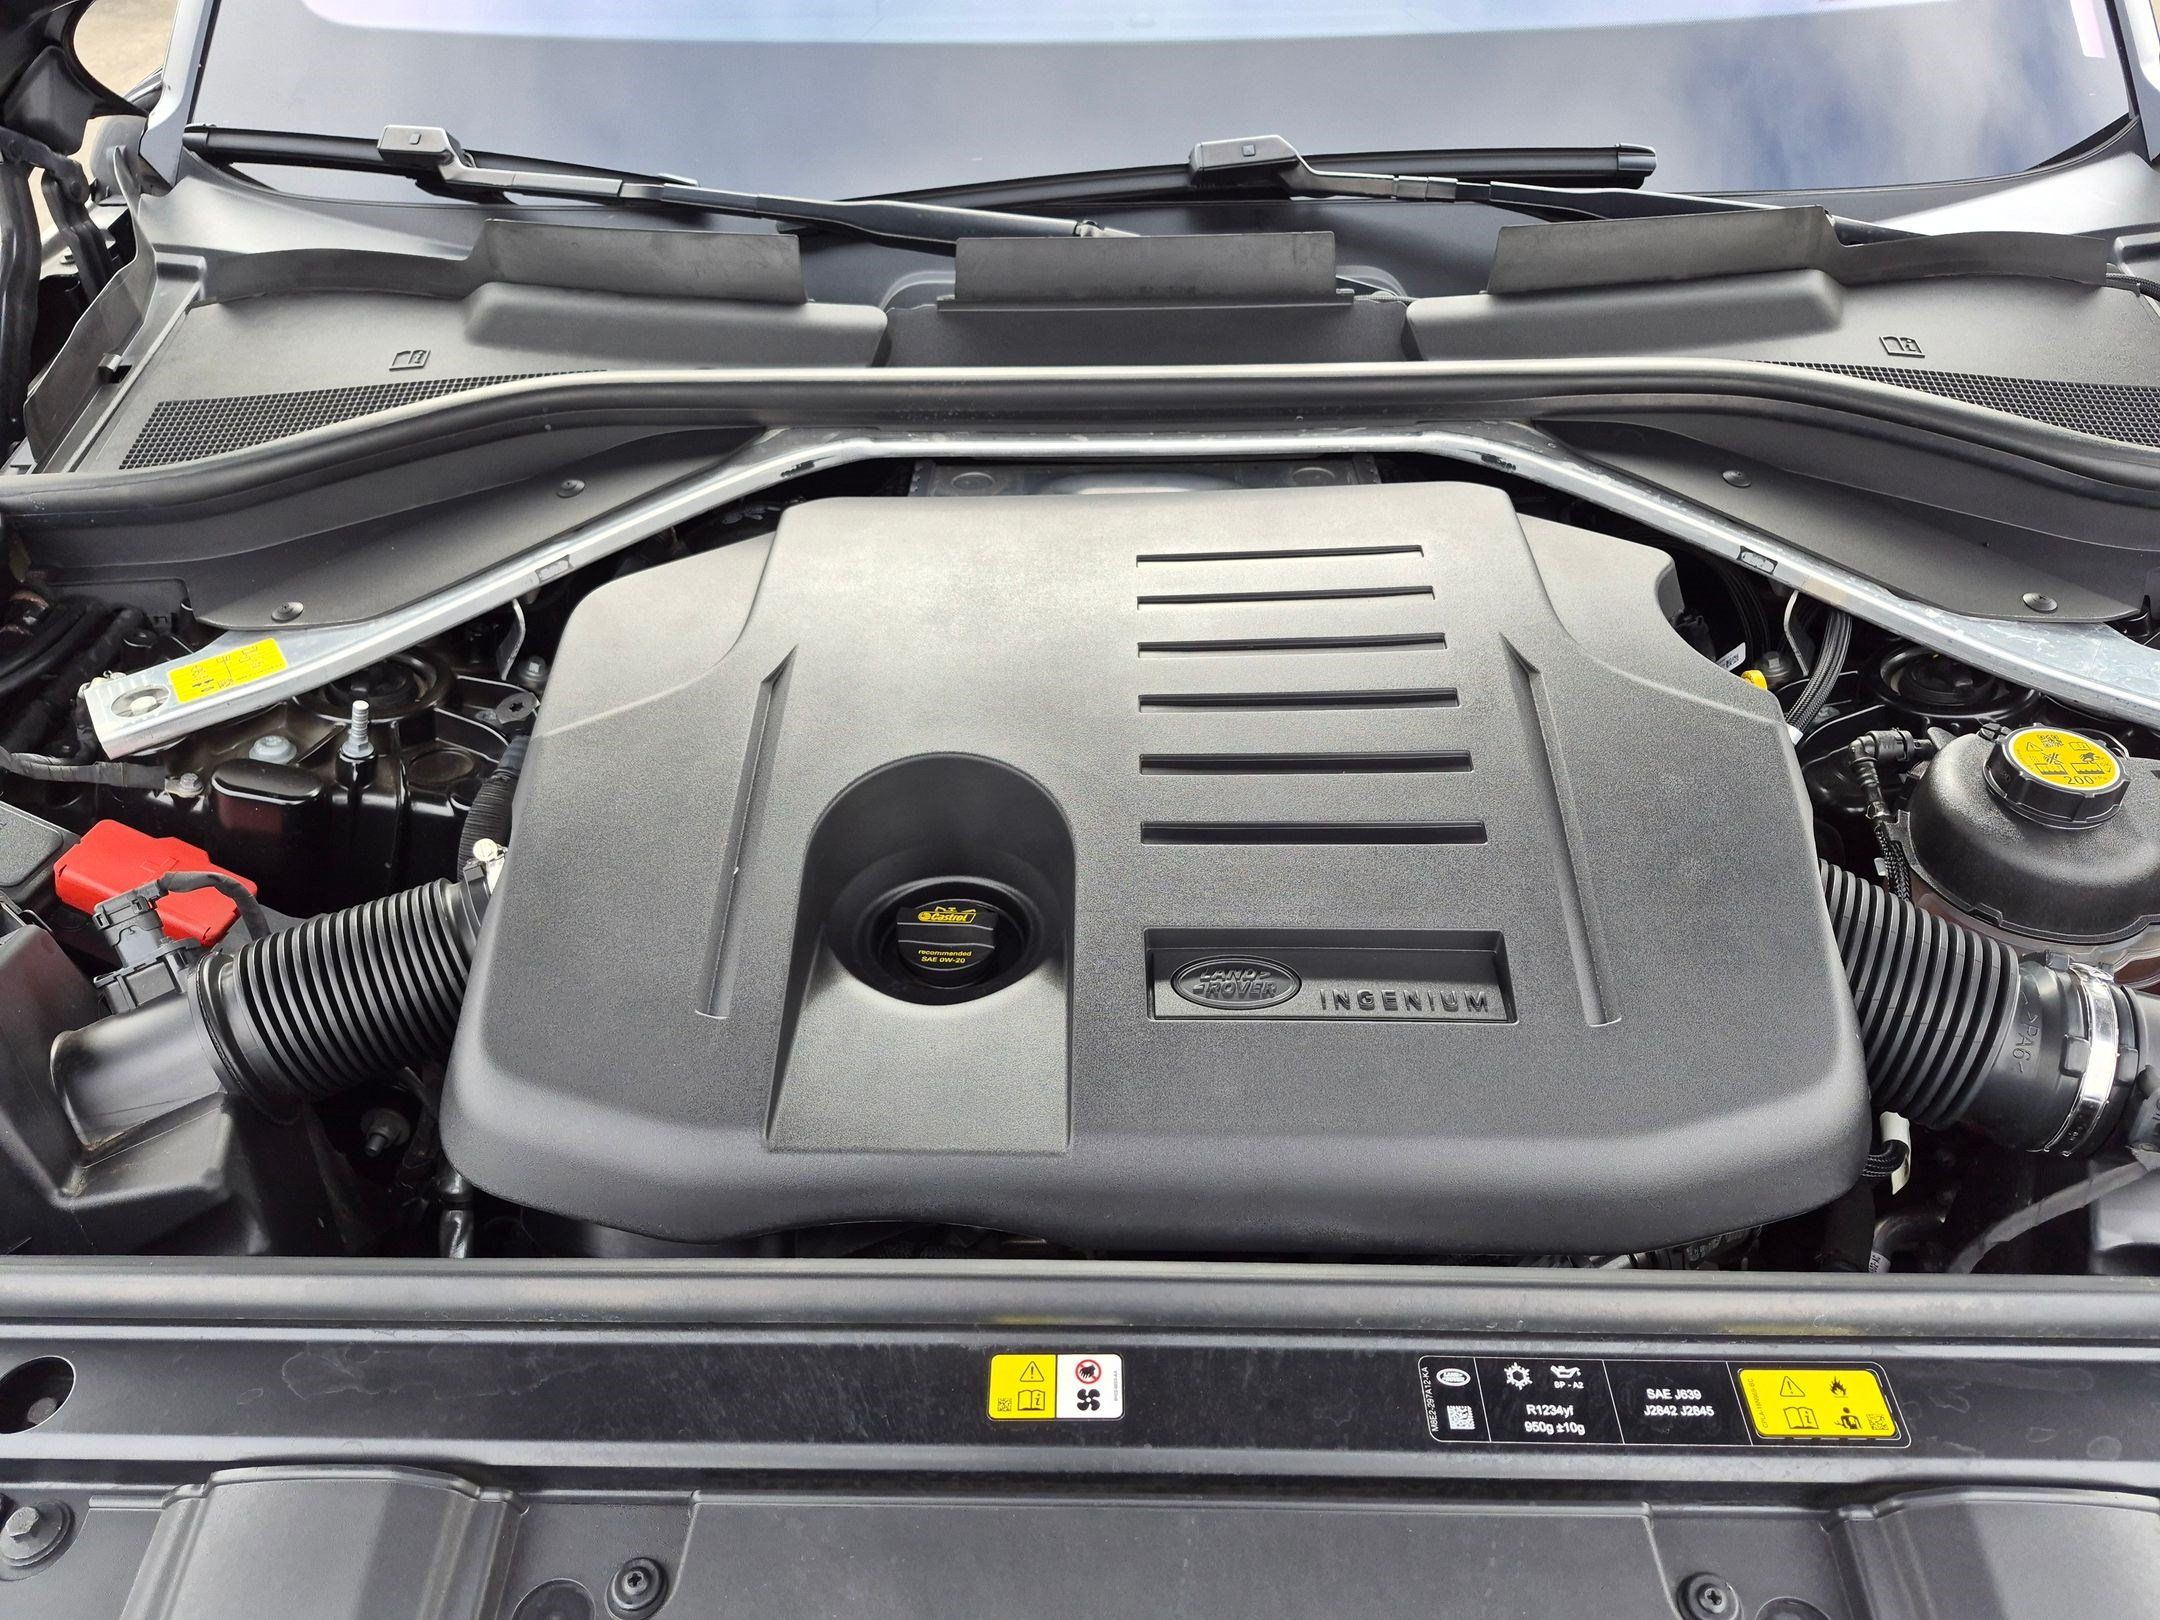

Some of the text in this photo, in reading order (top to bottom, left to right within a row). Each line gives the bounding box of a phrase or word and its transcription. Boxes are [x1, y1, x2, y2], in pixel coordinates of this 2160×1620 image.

[2064, 775, 2094, 785] 200
[931, 913, 968, 922] Castrol
[918, 949, 972, 957] recommended
[1200, 968, 1257, 982] LAND
[1206, 981, 1278, 999] ROVER
[1319, 988, 1489, 1013] INGENIUM
[1646, 1388, 1702, 1400] SAE J639
[1526, 1404, 1574, 1418] R1234yf
[1644, 1405, 1715, 1417] J2842 J2845
[1524, 1421, 1586, 1436] 950g ±10g
